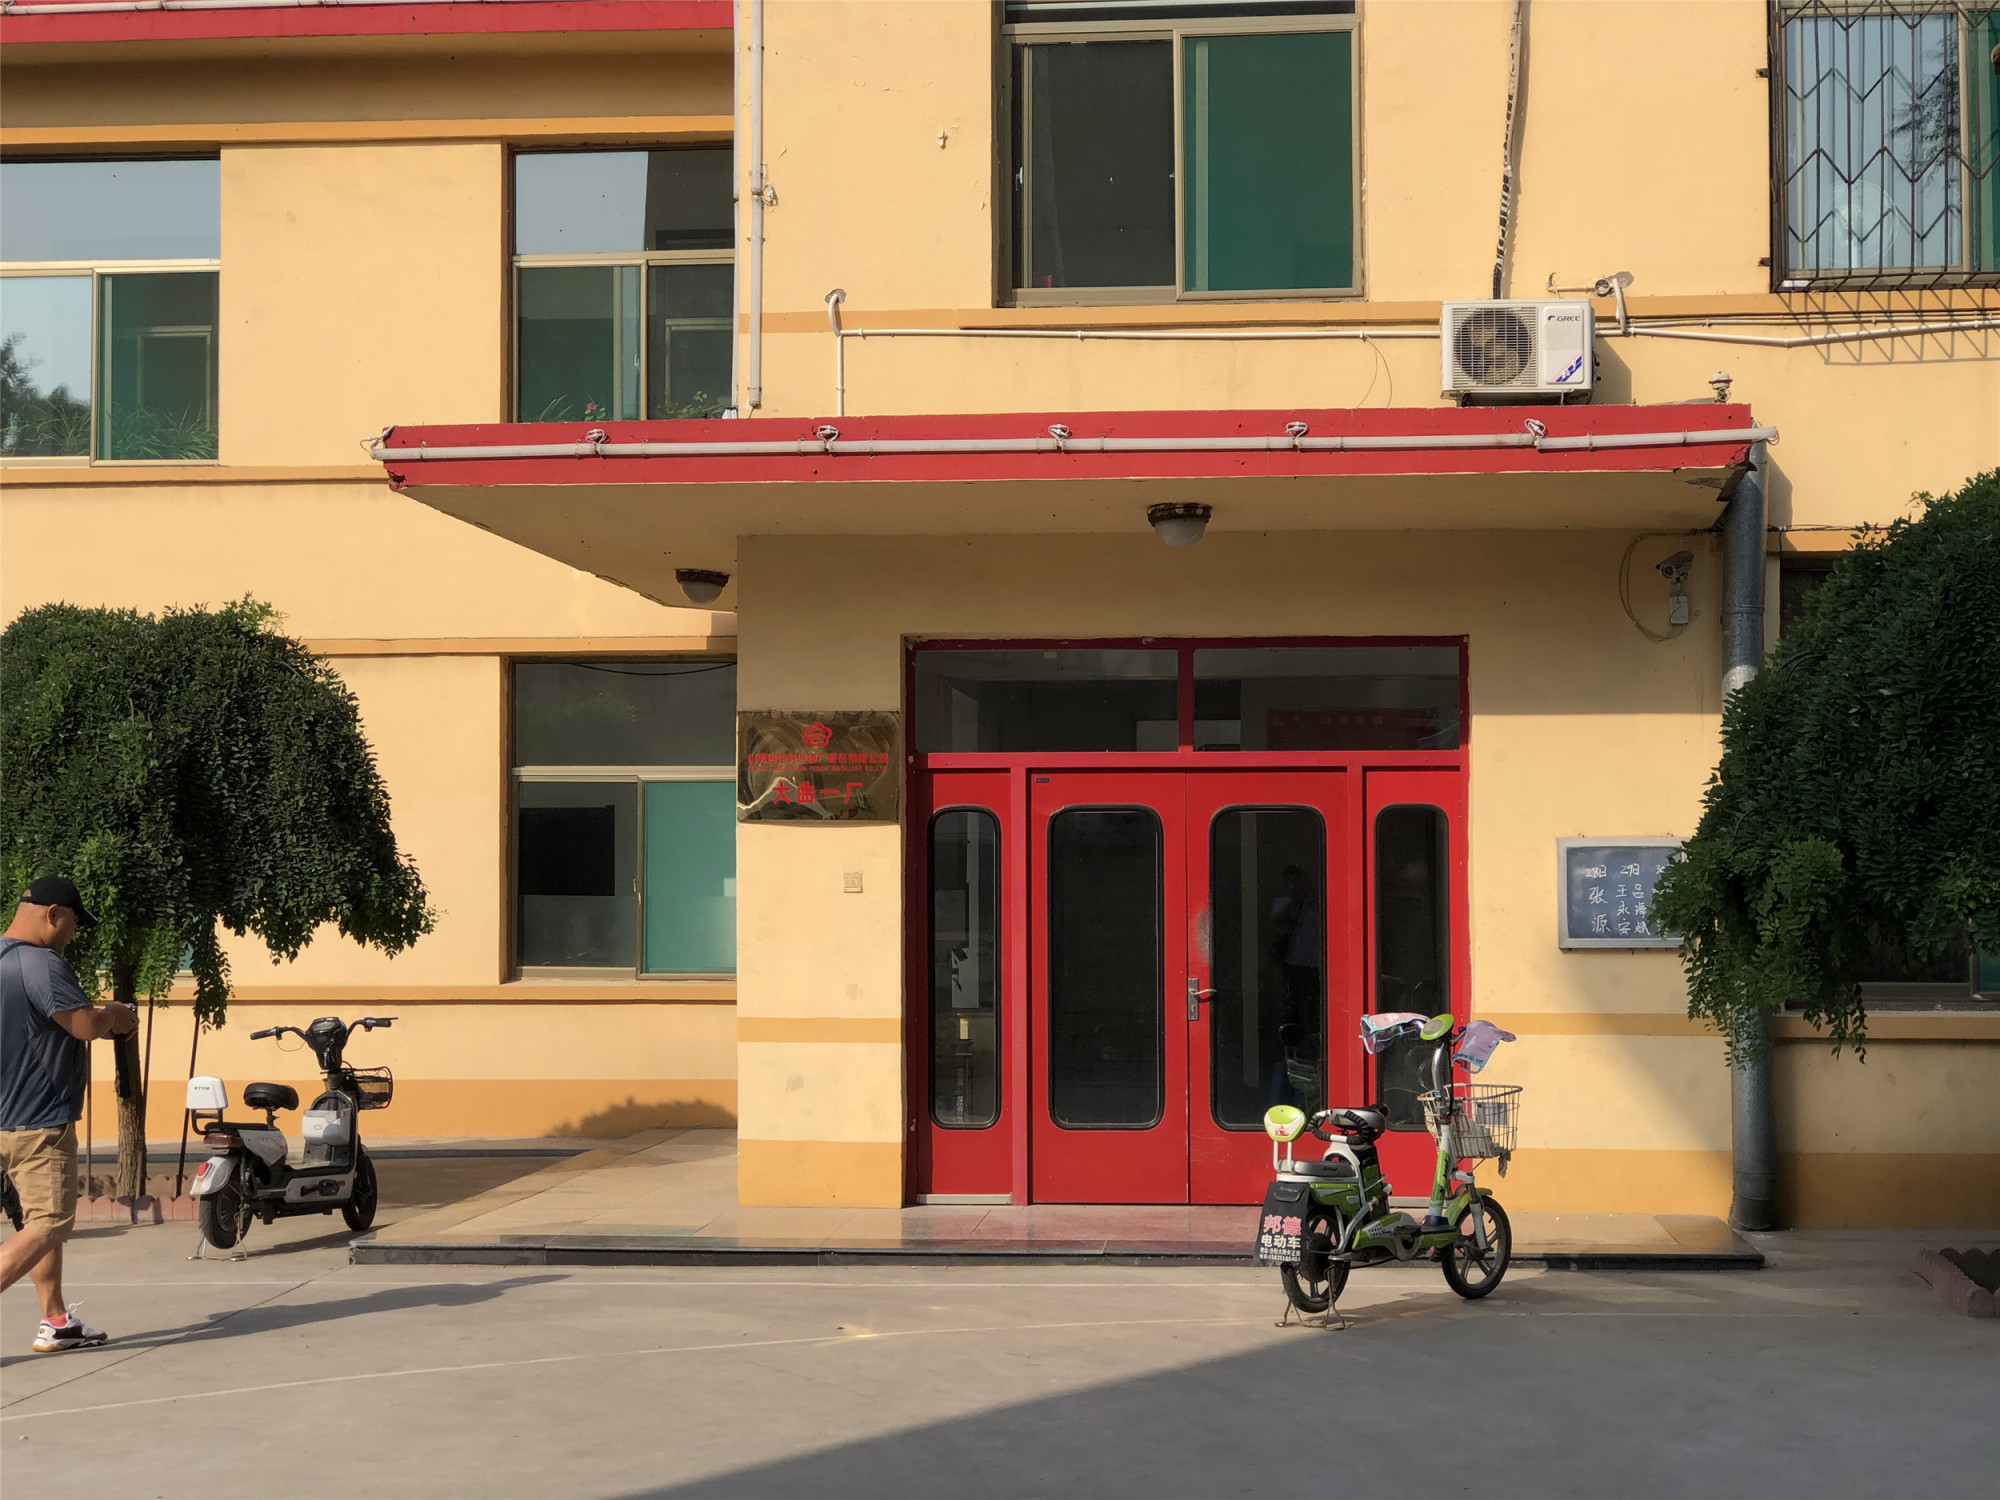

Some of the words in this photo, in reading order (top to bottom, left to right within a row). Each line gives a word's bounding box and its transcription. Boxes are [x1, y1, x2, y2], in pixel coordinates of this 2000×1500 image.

[772, 781, 863, 805] 大曲一厂
[1585, 864, 1607, 878] 28日
[1620, 863, 1640, 877] 29日
[1263, 1214, 1302, 1236] 邦德
[1261, 1234, 1301, 1249] 电动车
